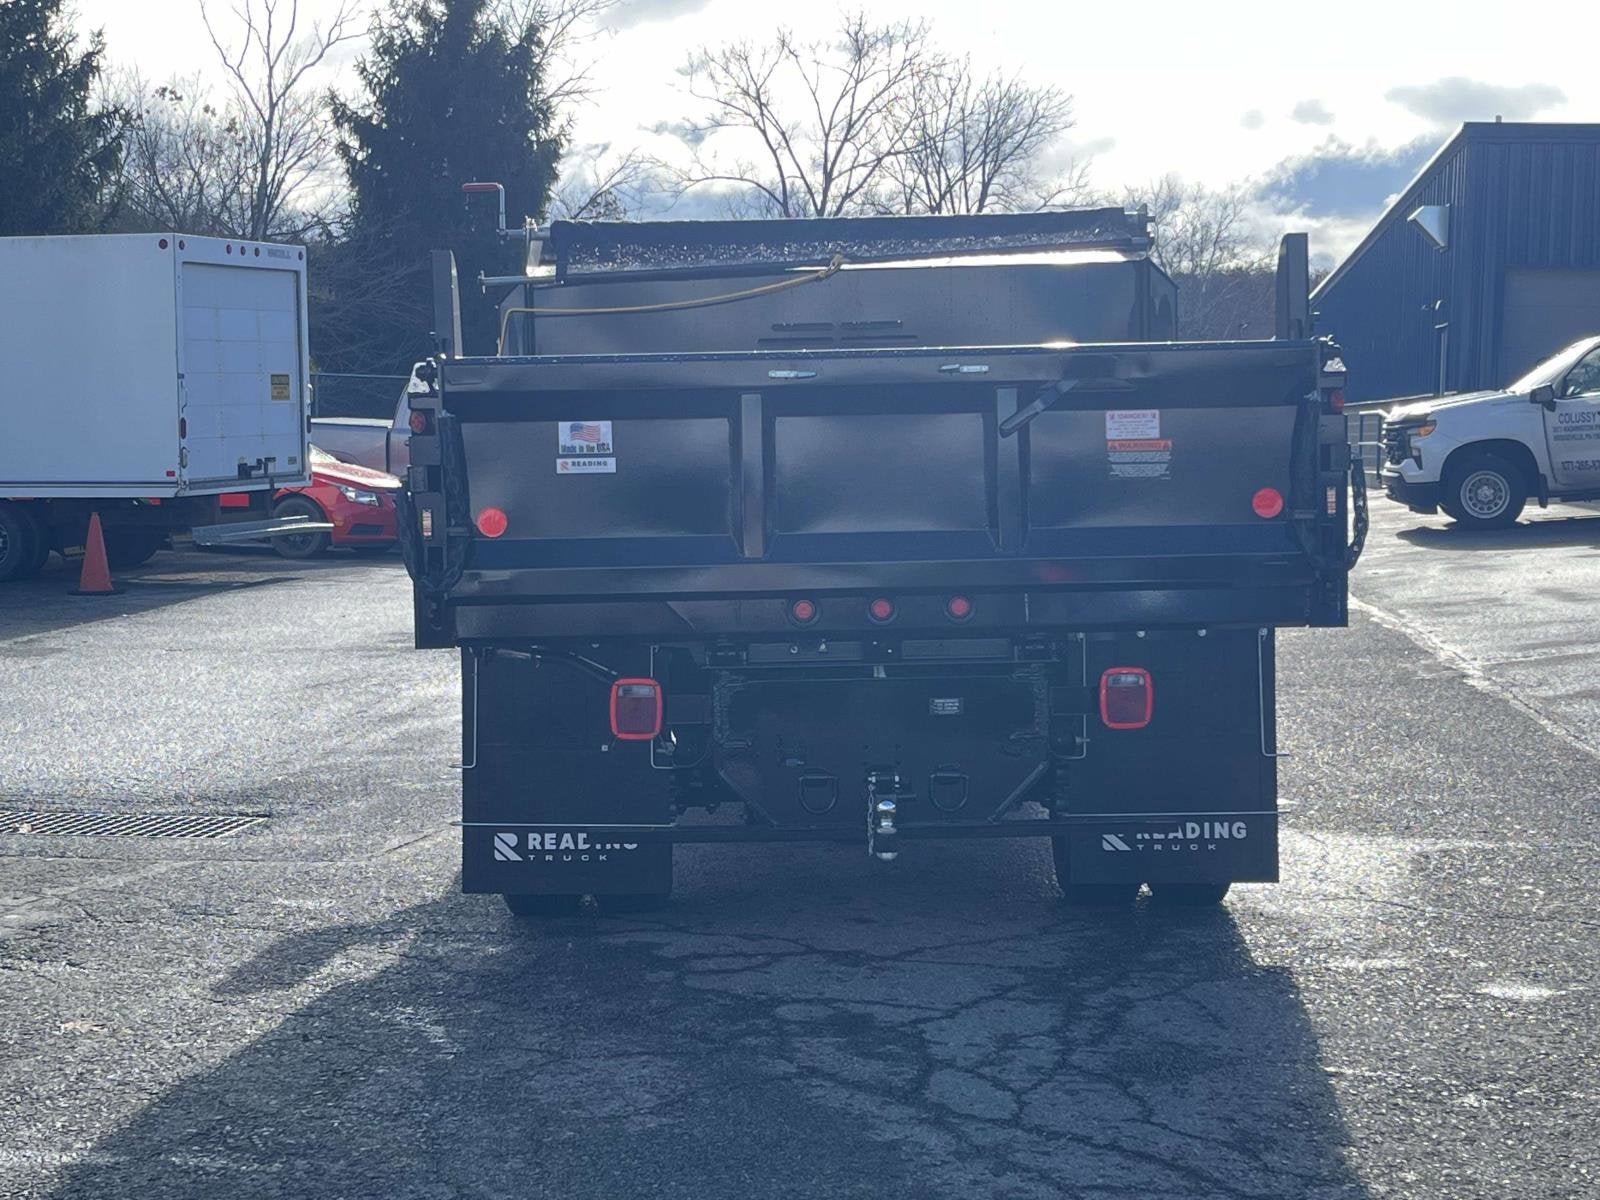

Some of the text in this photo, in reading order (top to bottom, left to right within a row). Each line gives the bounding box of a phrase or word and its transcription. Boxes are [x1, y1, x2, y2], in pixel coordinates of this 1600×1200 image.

[1559, 411, 1596, 424] COLUSSY
[561, 444, 577, 453] Made
[579, 444, 584, 453] in
[597, 442, 610, 452] USA
[1118, 442, 1162, 450] WARNING
